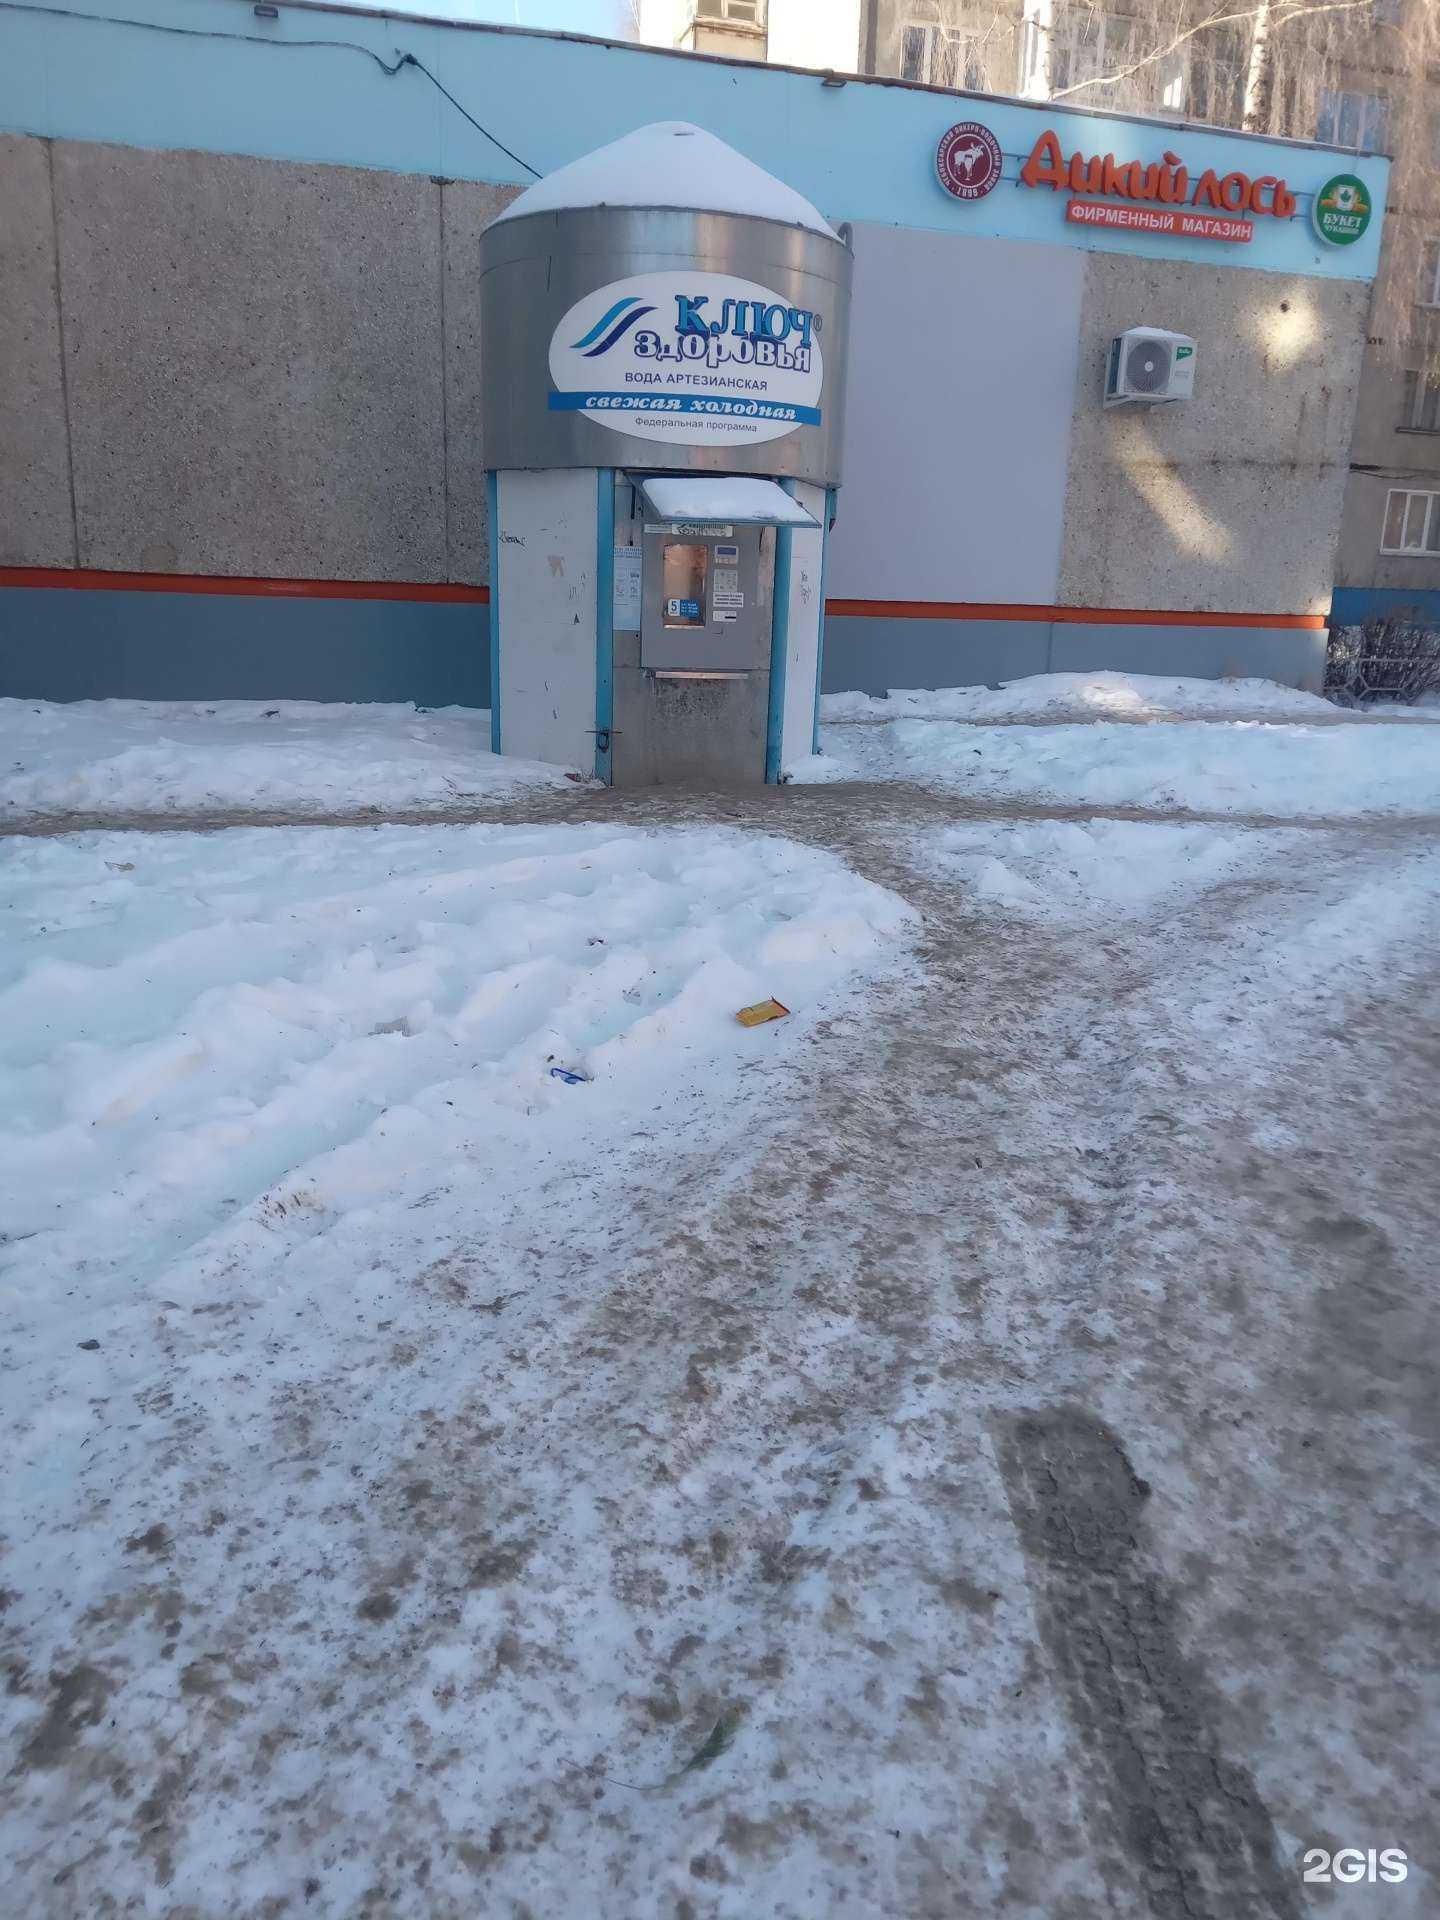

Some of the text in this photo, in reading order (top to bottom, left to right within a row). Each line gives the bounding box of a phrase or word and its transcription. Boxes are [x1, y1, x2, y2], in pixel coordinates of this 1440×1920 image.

[1071, 204, 1251, 238] ФИРМЕННЫЙ МАГАЗИН
[1323, 212, 1362, 228] БУКЕТ
[624, 372, 768, 391] ВОДА АРТЕЗИАНСКАЯ
[585, 396, 797, 420] свежая холодная
[635, 416, 758, 433] Федеральная программа
[671, 600, 678, 611] 5
